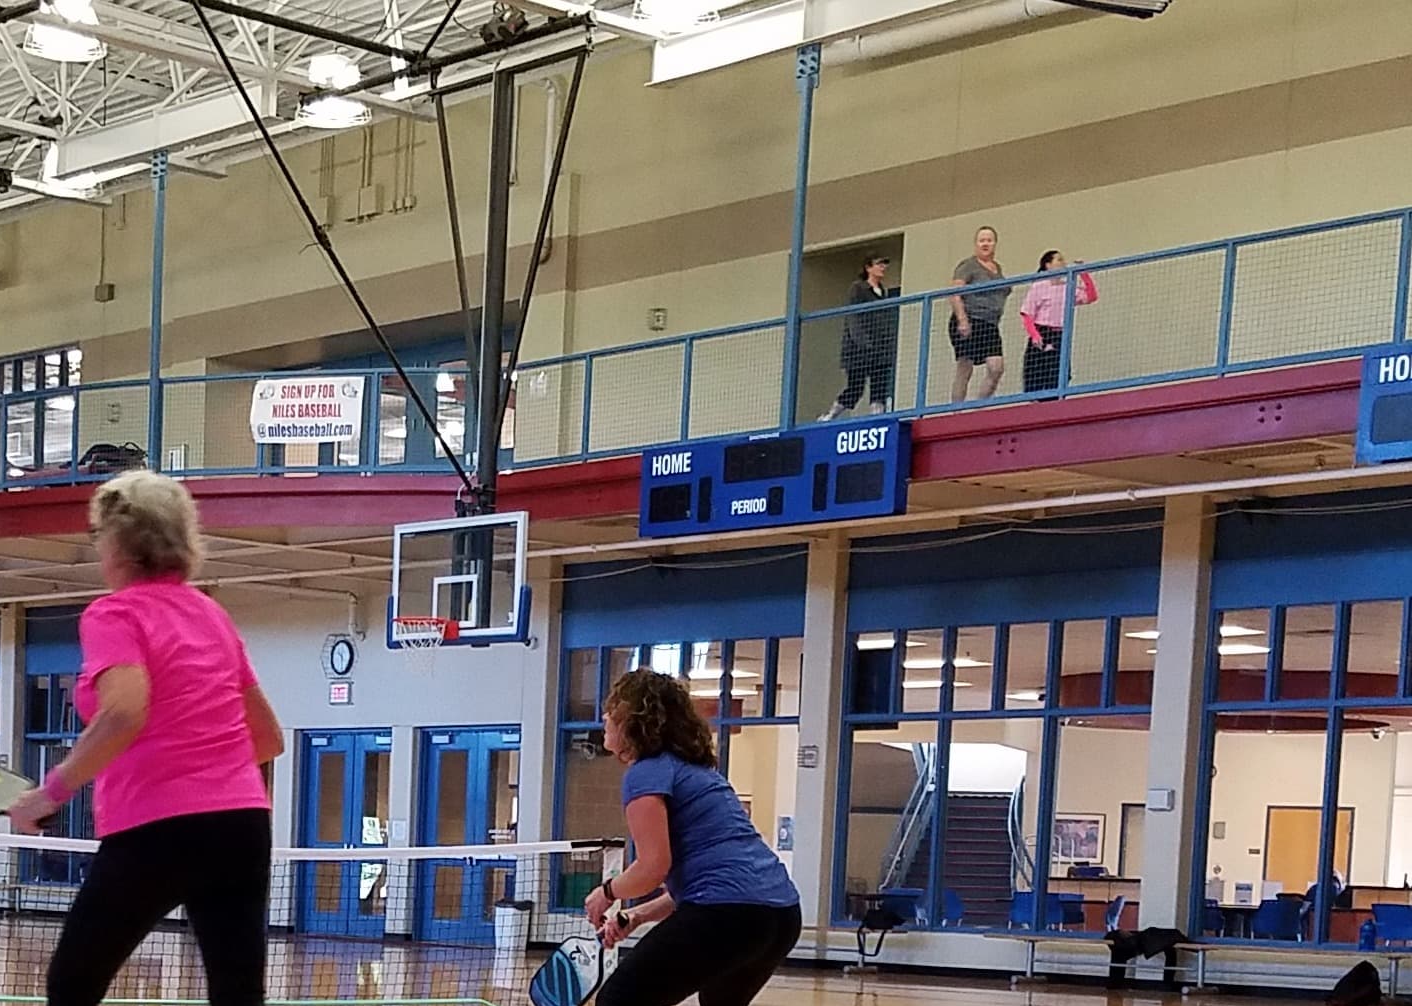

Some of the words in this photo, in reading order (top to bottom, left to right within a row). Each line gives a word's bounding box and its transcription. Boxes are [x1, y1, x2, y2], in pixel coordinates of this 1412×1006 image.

[1378, 354, 1412, 384] HO
[281, 385, 302, 399] SIGN
[304, 385, 317, 398] UP
[318, 384, 335, 398] FOR
[272, 404, 296, 418] NILES
[298, 403, 342, 418] BASEBALL
[836, 427, 889, 454] GUEST
[651, 452, 692, 477] HOME
[730, 497, 767, 516] PERIOD
